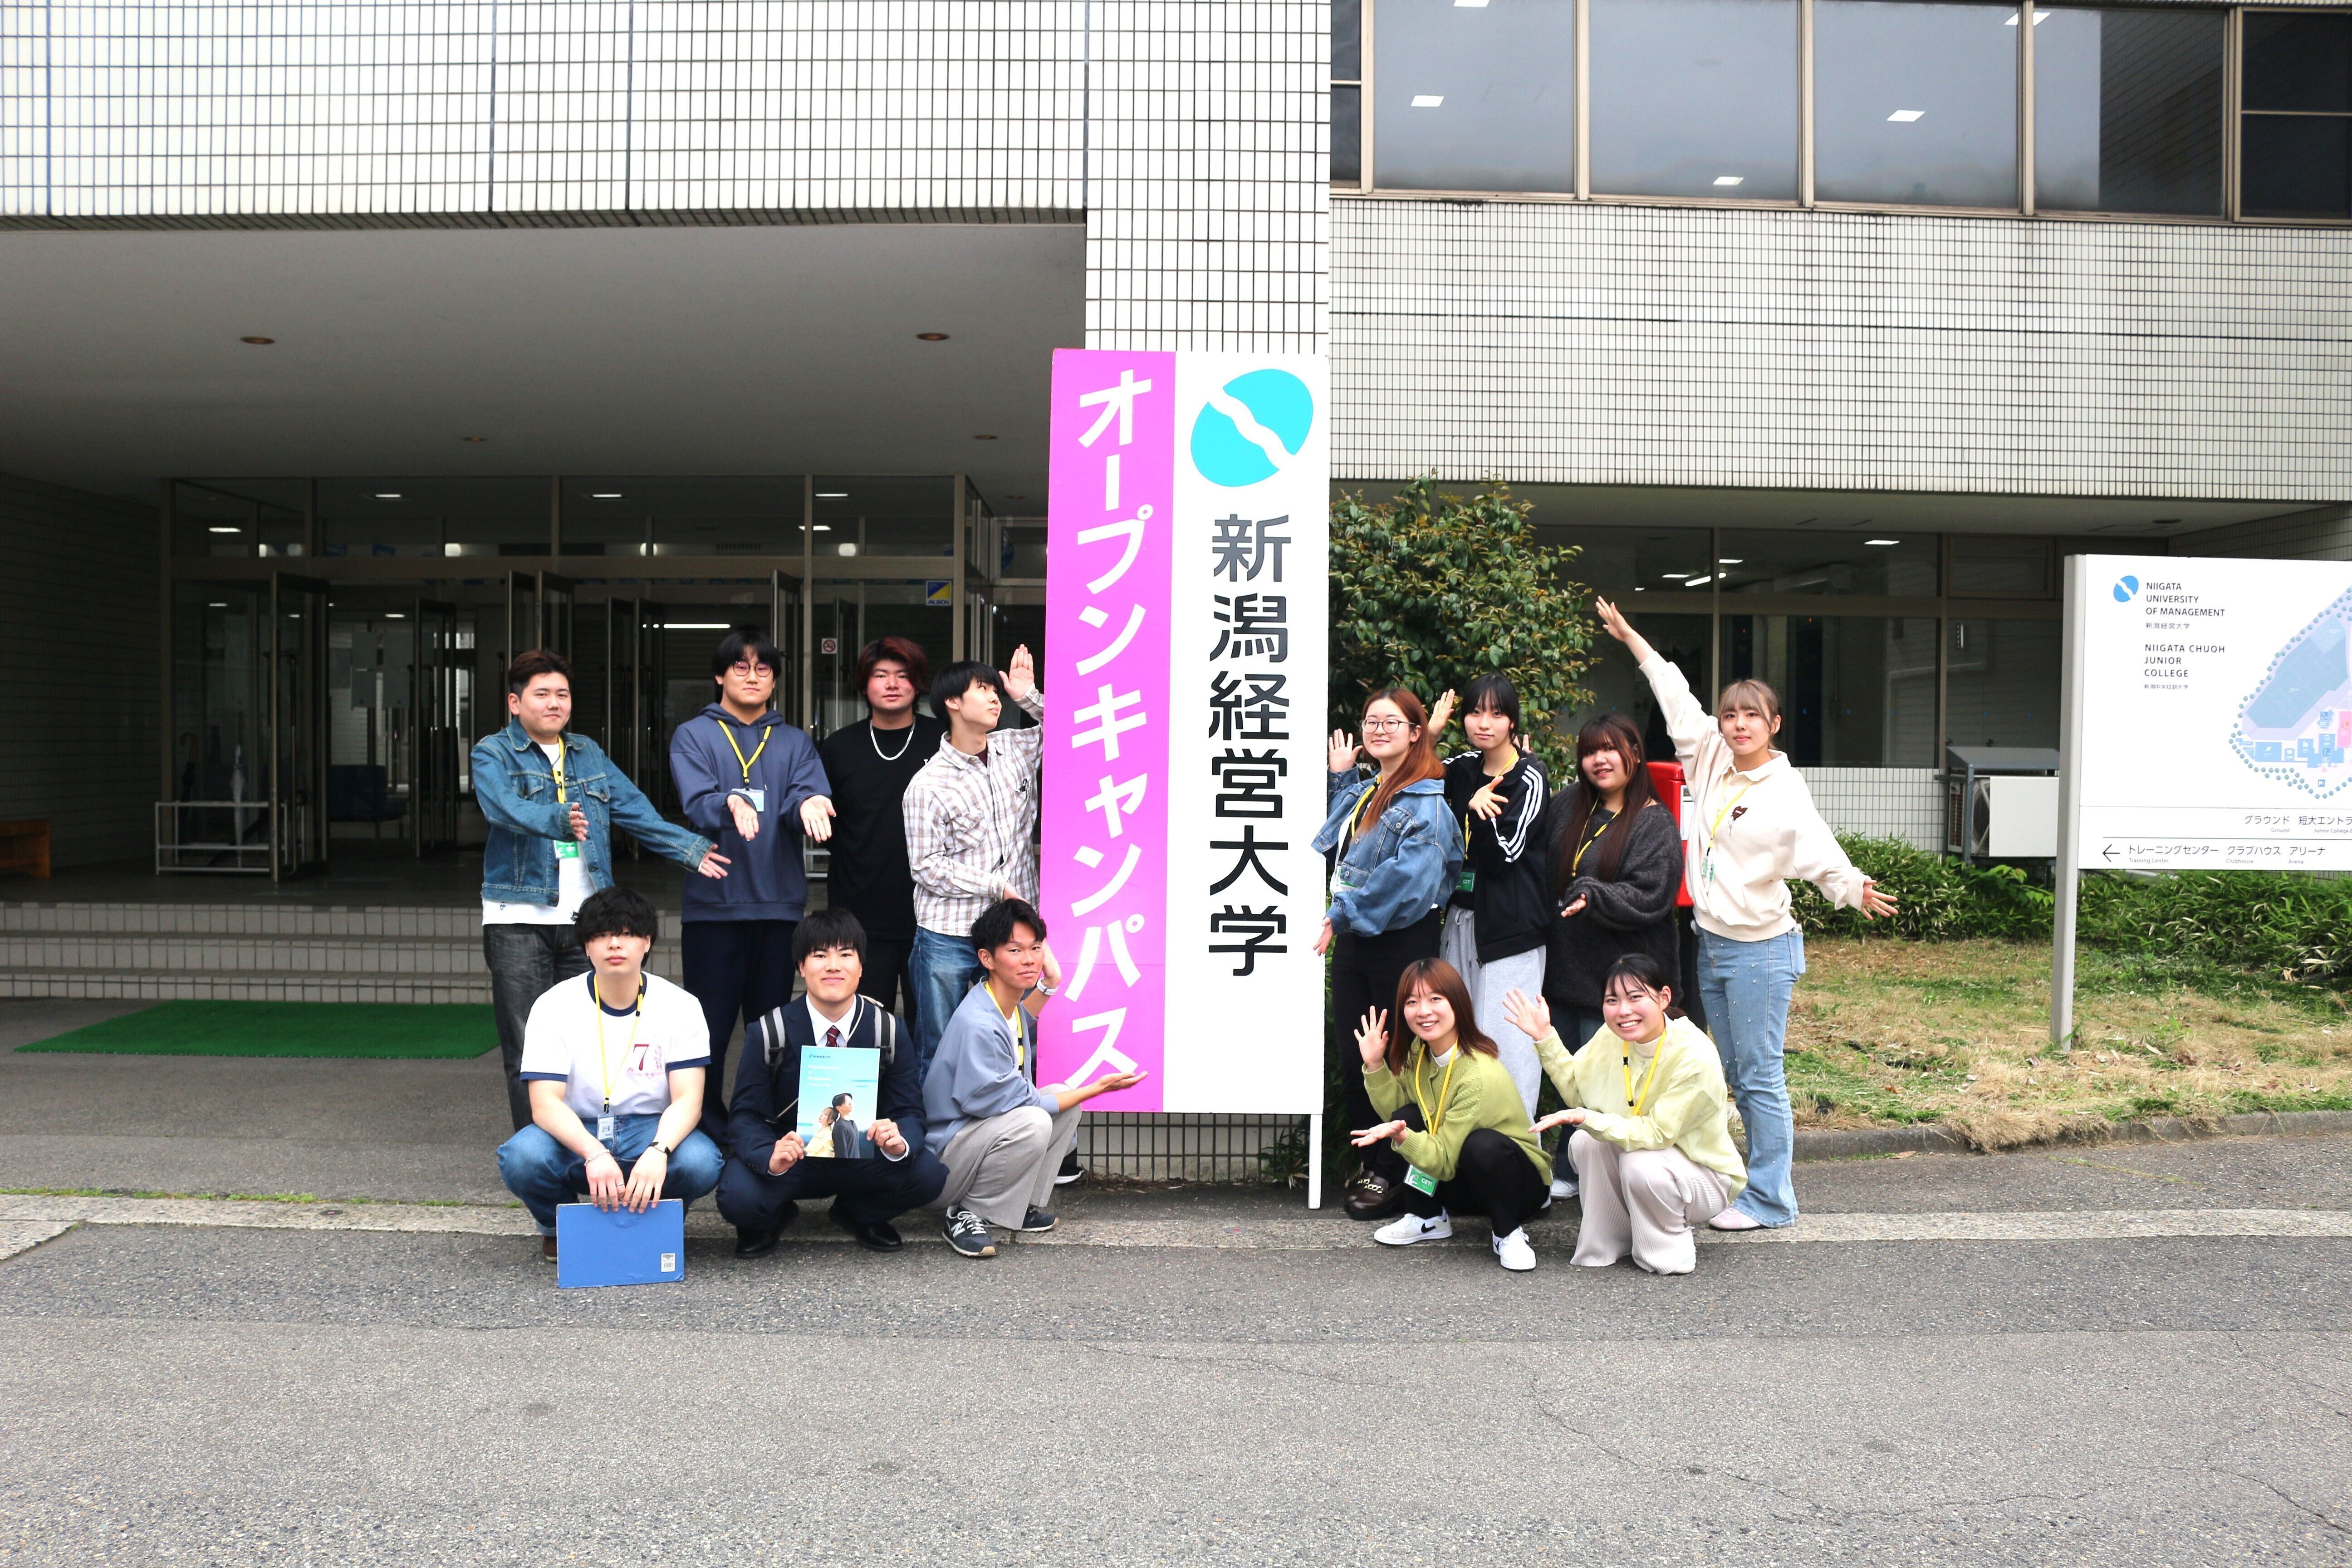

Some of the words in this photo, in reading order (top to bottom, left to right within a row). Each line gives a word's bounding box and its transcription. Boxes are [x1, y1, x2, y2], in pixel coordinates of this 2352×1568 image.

[2146, 582, 2181, 590] NIIGATA
[2146, 595, 2199, 603] UNIVERSITY
[2160, 608, 2225, 616] MANAGEMENT
[2144, 669, 2189, 677] COLLEGE
[1064, 369, 1153, 1089] オープンキャンパス
[1209, 514, 1291, 976] 新潟経営大学
[2245, 815, 2290, 824] グラウンド
[2129, 845, 2219, 855] トレーニングセンター
[2227, 845, 2281, 855] クラブハウス
[2290, 846, 2325, 856] アリーナ
[633, 1044, 649, 1071] 7
